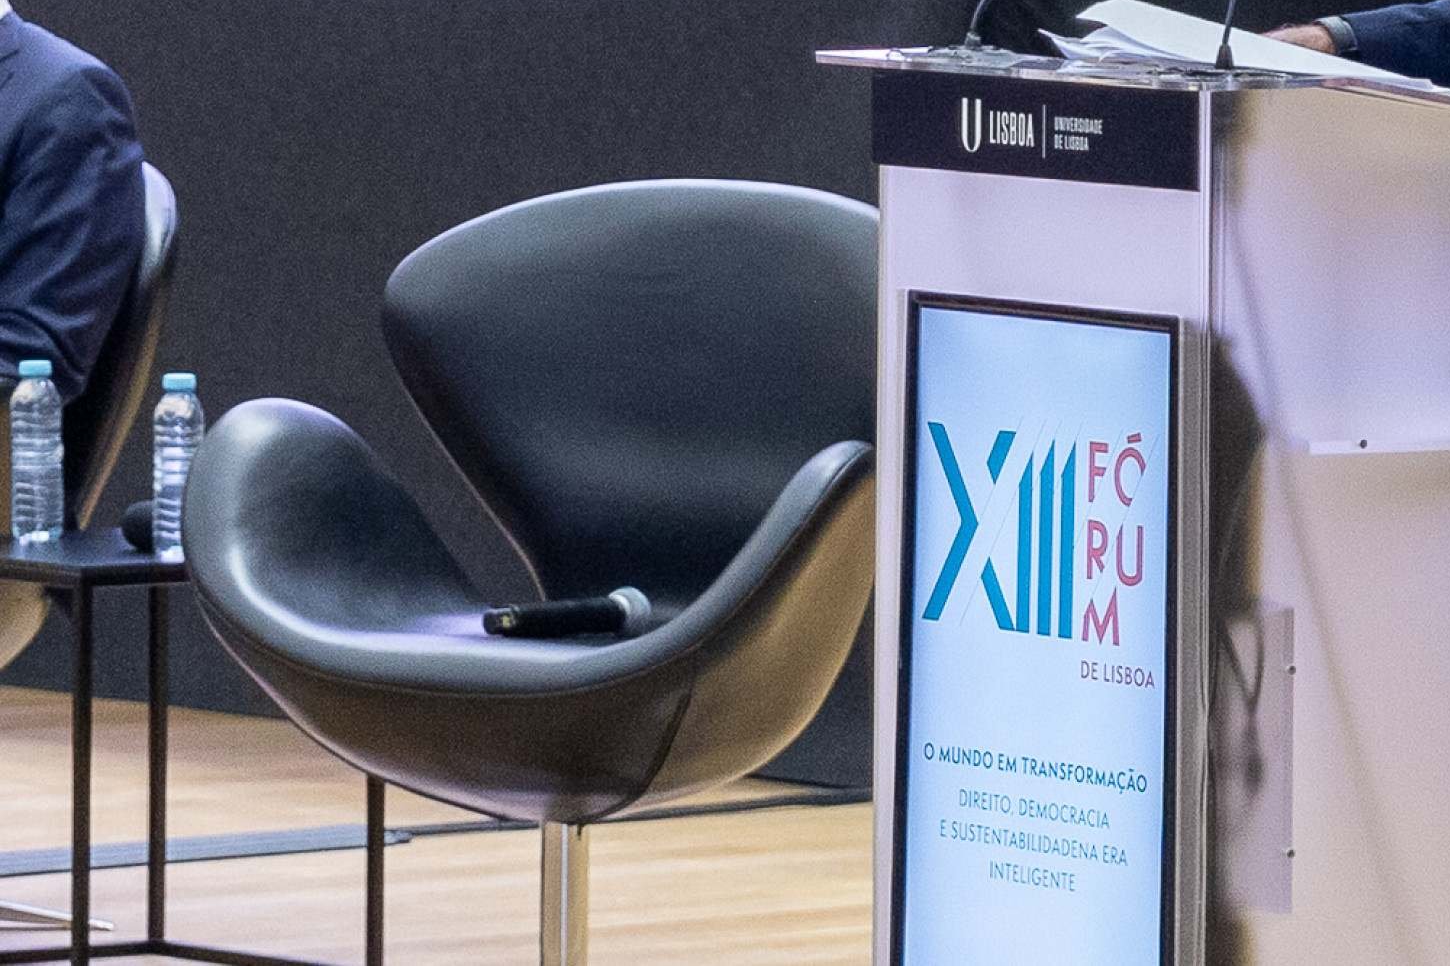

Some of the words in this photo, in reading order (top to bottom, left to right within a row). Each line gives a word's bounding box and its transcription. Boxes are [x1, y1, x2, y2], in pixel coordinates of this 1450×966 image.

[989, 110, 1035, 148] LISBOA
[1054, 134, 1063, 149] DE
[922, 420, 1077, 640] XIII
[1080, 660, 1099, 681] DE
[1103, 665, 1155, 689] LISBOA
[924, 742, 935, 760] O
[938, 746, 994, 770] MUNDO
[998, 753, 1018, 774] EM
[1021, 757, 1148, 794] TRANSFORMAÇÃO
[959, 789, 1014, 816] DIREITO,
[1018, 798, 1110, 829] DEMOCRACIA
[940, 819, 948, 838] E
[1102, 845, 1128, 867] ERA
[989, 861, 1077, 892] INTELIGENTE
